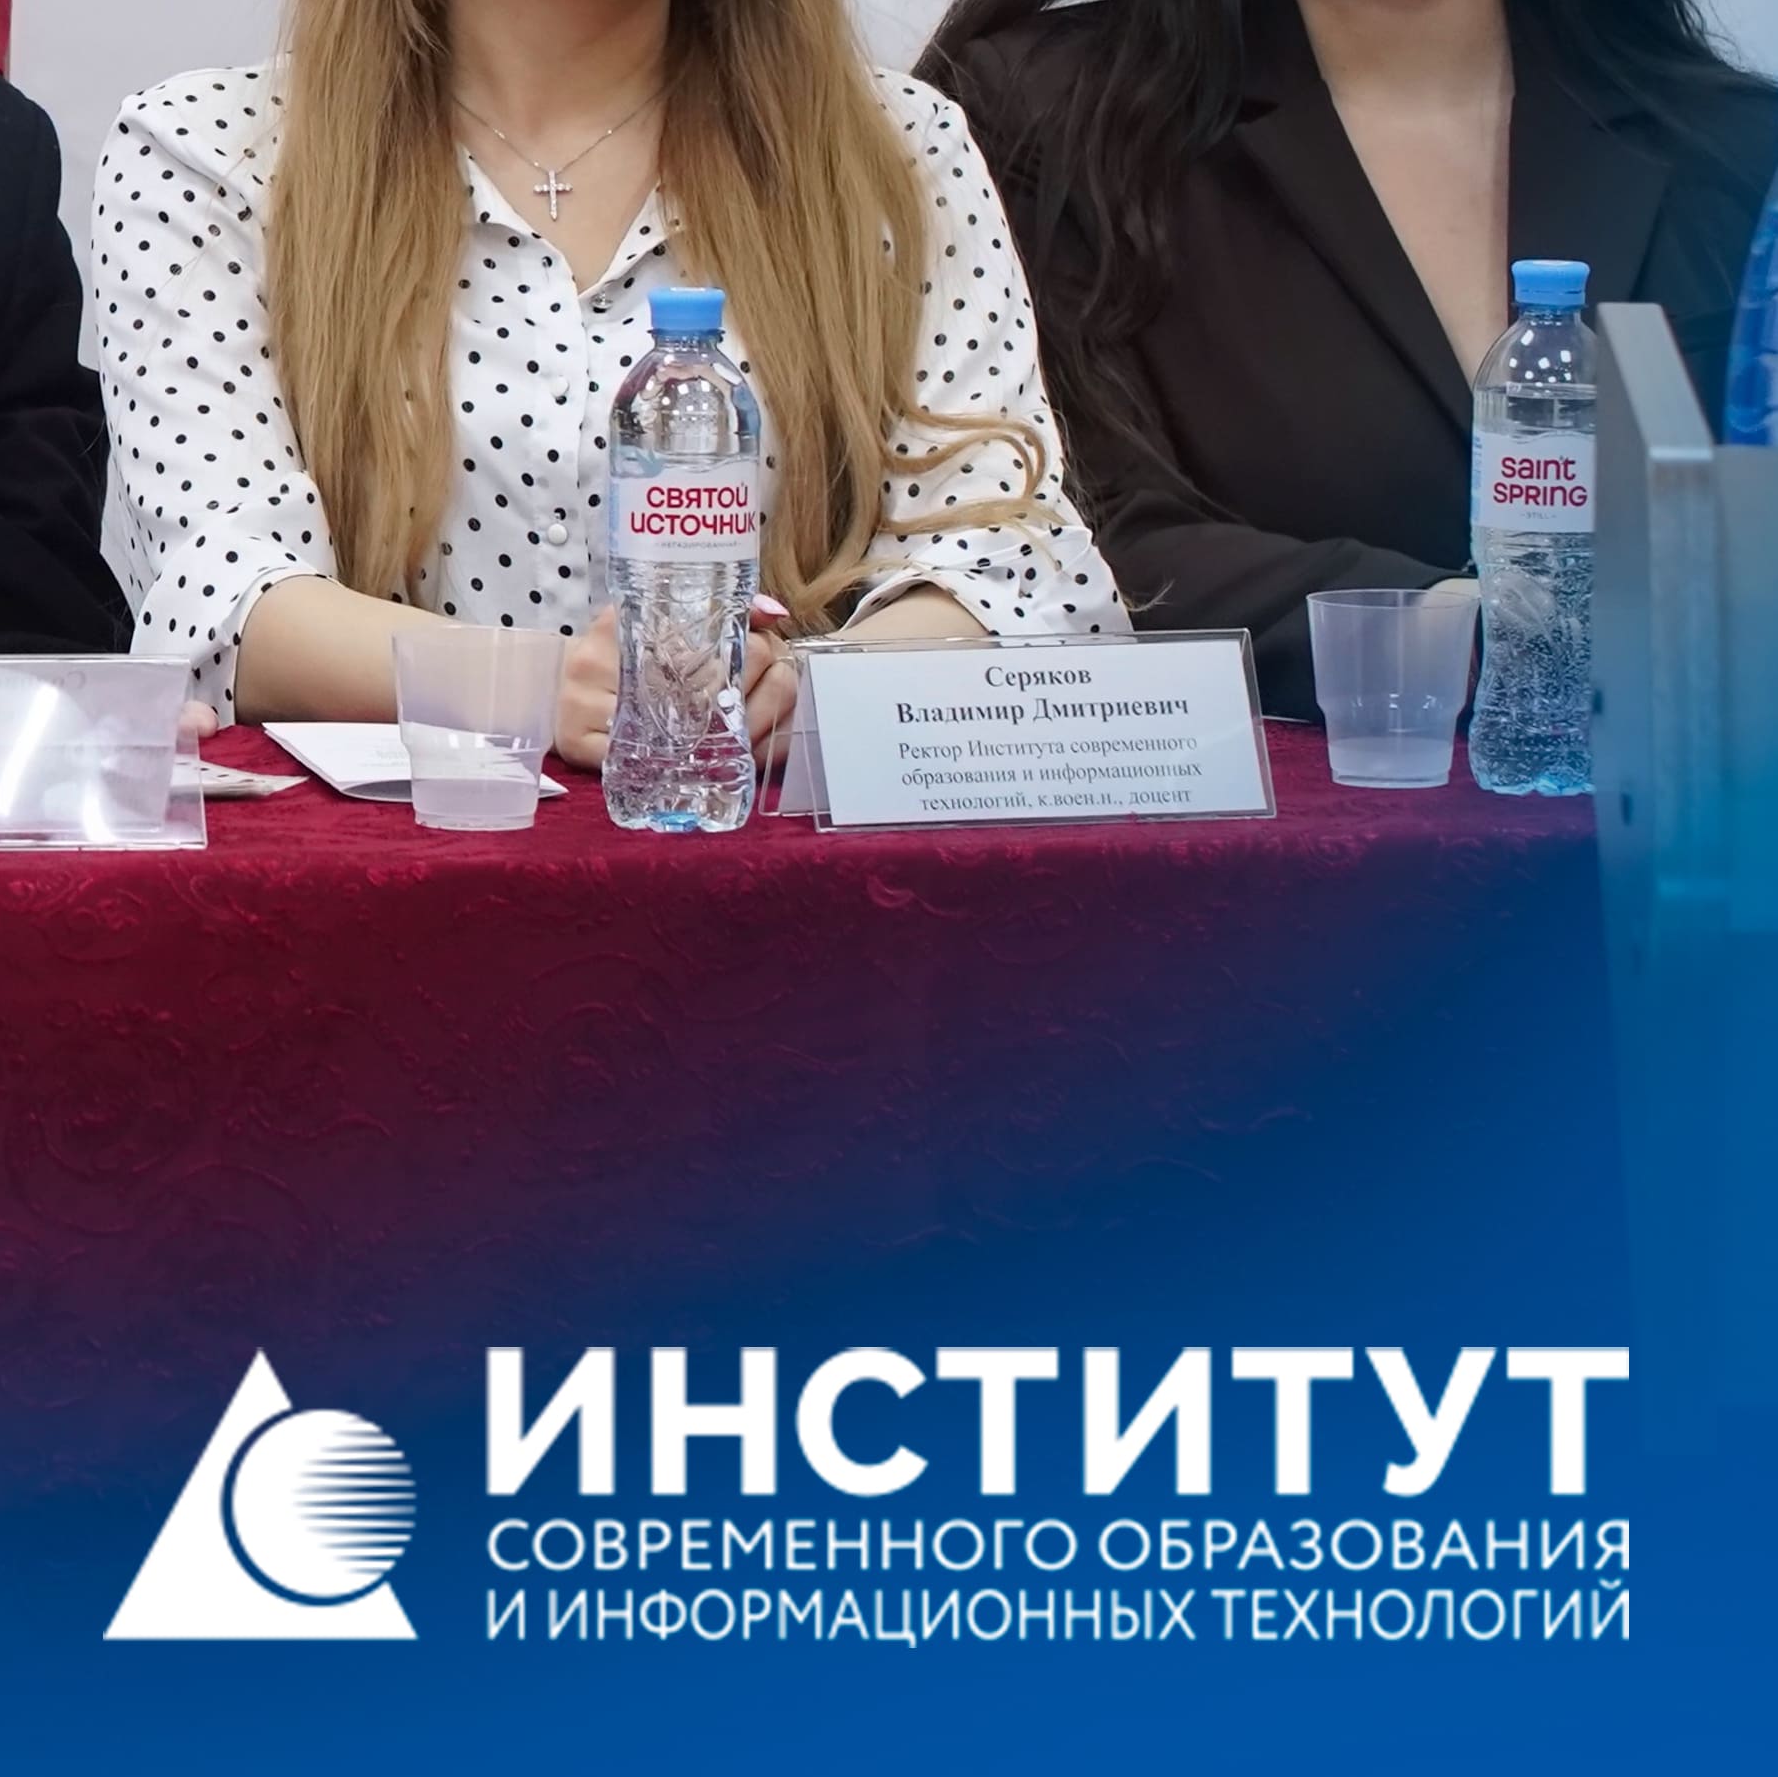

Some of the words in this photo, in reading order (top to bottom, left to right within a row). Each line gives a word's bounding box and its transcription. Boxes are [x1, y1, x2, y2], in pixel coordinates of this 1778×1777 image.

[646, 482, 748, 508] СВЯТОЙ
[631, 511, 756, 536] ИСТОЧНИК
[985, 666, 1092, 691] Серяков
[897, 701, 1025, 725] Владимир
[1032, 697, 1189, 722] Дмитриевич
[899, 742, 963, 763] Ректор
[968, 739, 1065, 762] Института
[1070, 735, 1197, 758] современного
[902, 767, 1017, 789] образования
[1023, 770, 1034, 782] и
[1039, 762, 1203, 784] информационных
[920, 791, 1033, 811] технологий,
[1129, 787, 1193, 807] доцент
